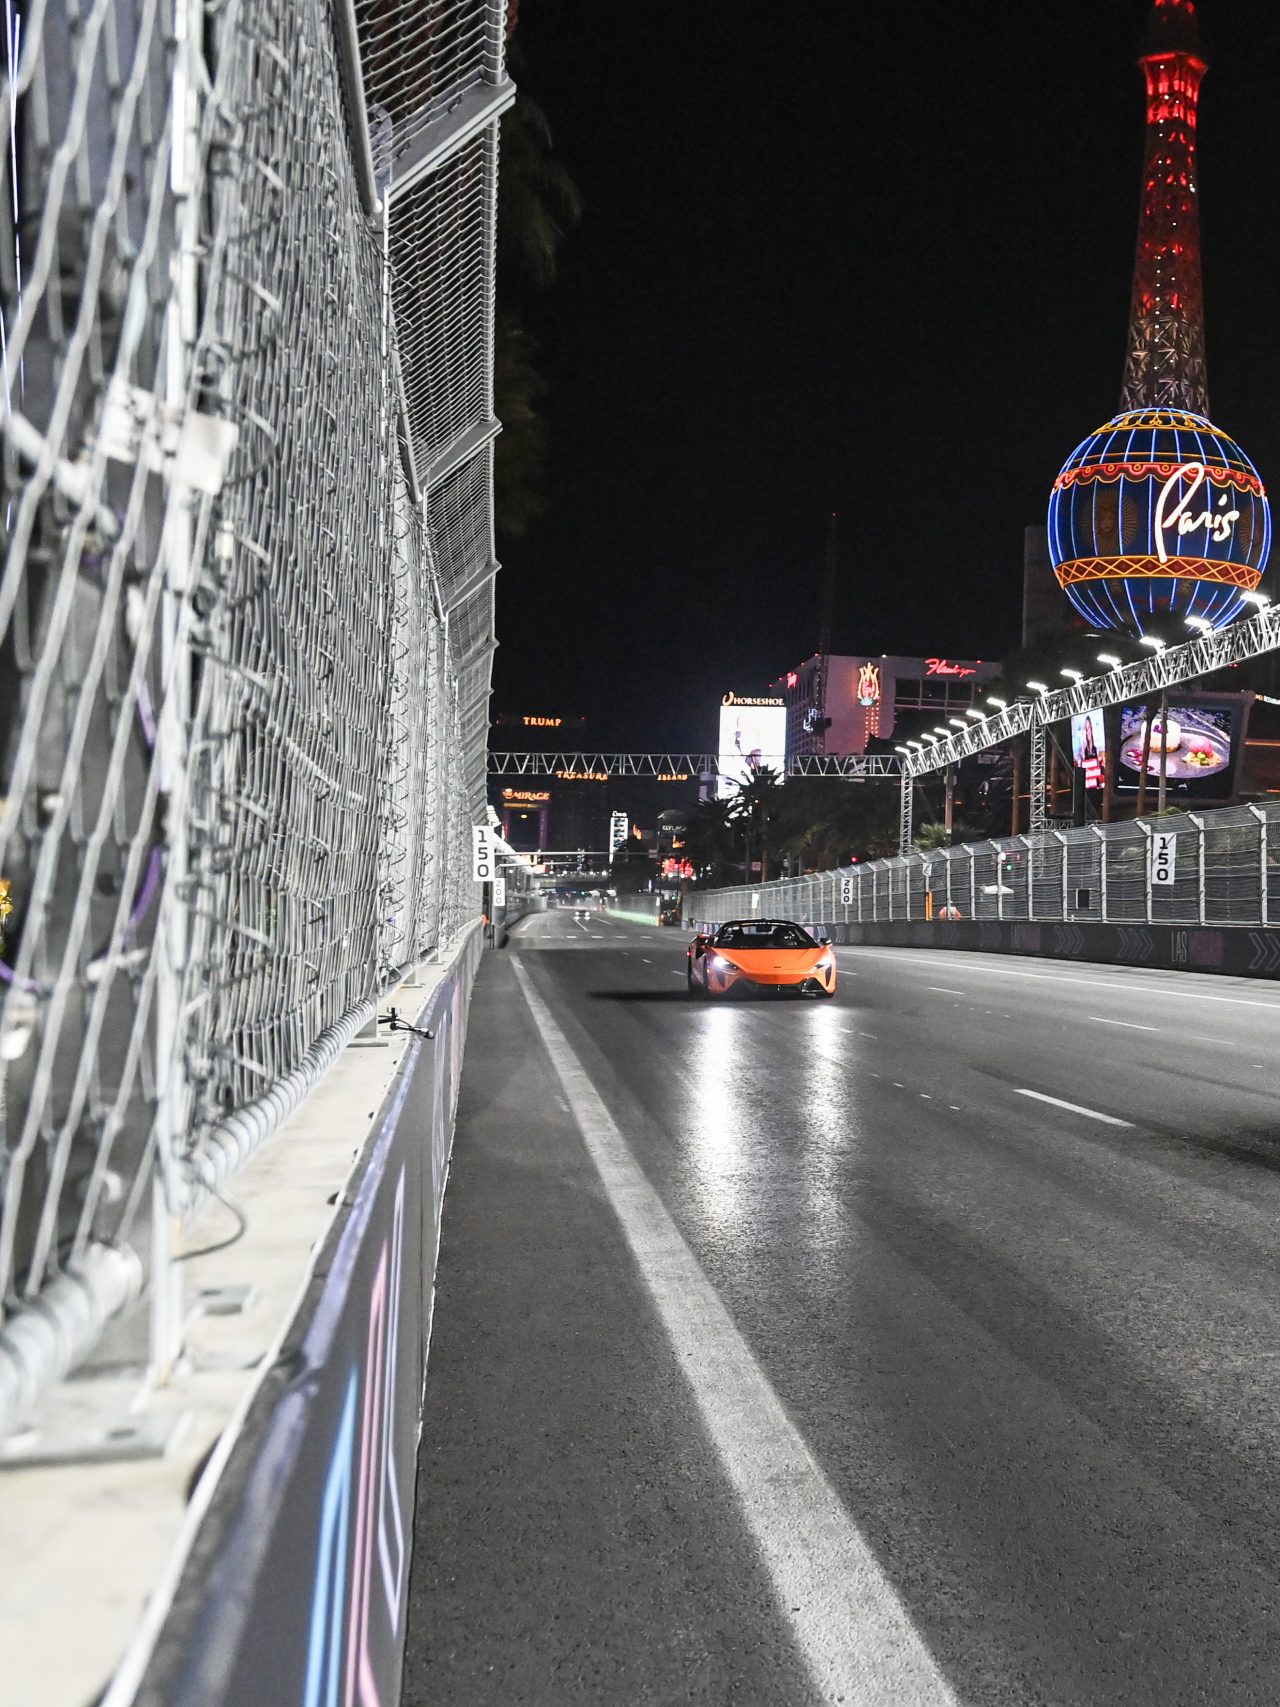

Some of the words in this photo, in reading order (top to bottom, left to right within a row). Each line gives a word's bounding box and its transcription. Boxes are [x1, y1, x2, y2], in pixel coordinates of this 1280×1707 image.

[1155, 462, 1240, 563] Paris
[733, 697, 785, 706] HORSESHOE
[522, 716, 562, 727] TRUMP
[556, 771, 608, 781] TREASURE
[513, 791, 550, 801] MIRAGE
[477, 830, 489, 878] 150
[1156, 836, 1169, 881] 150
